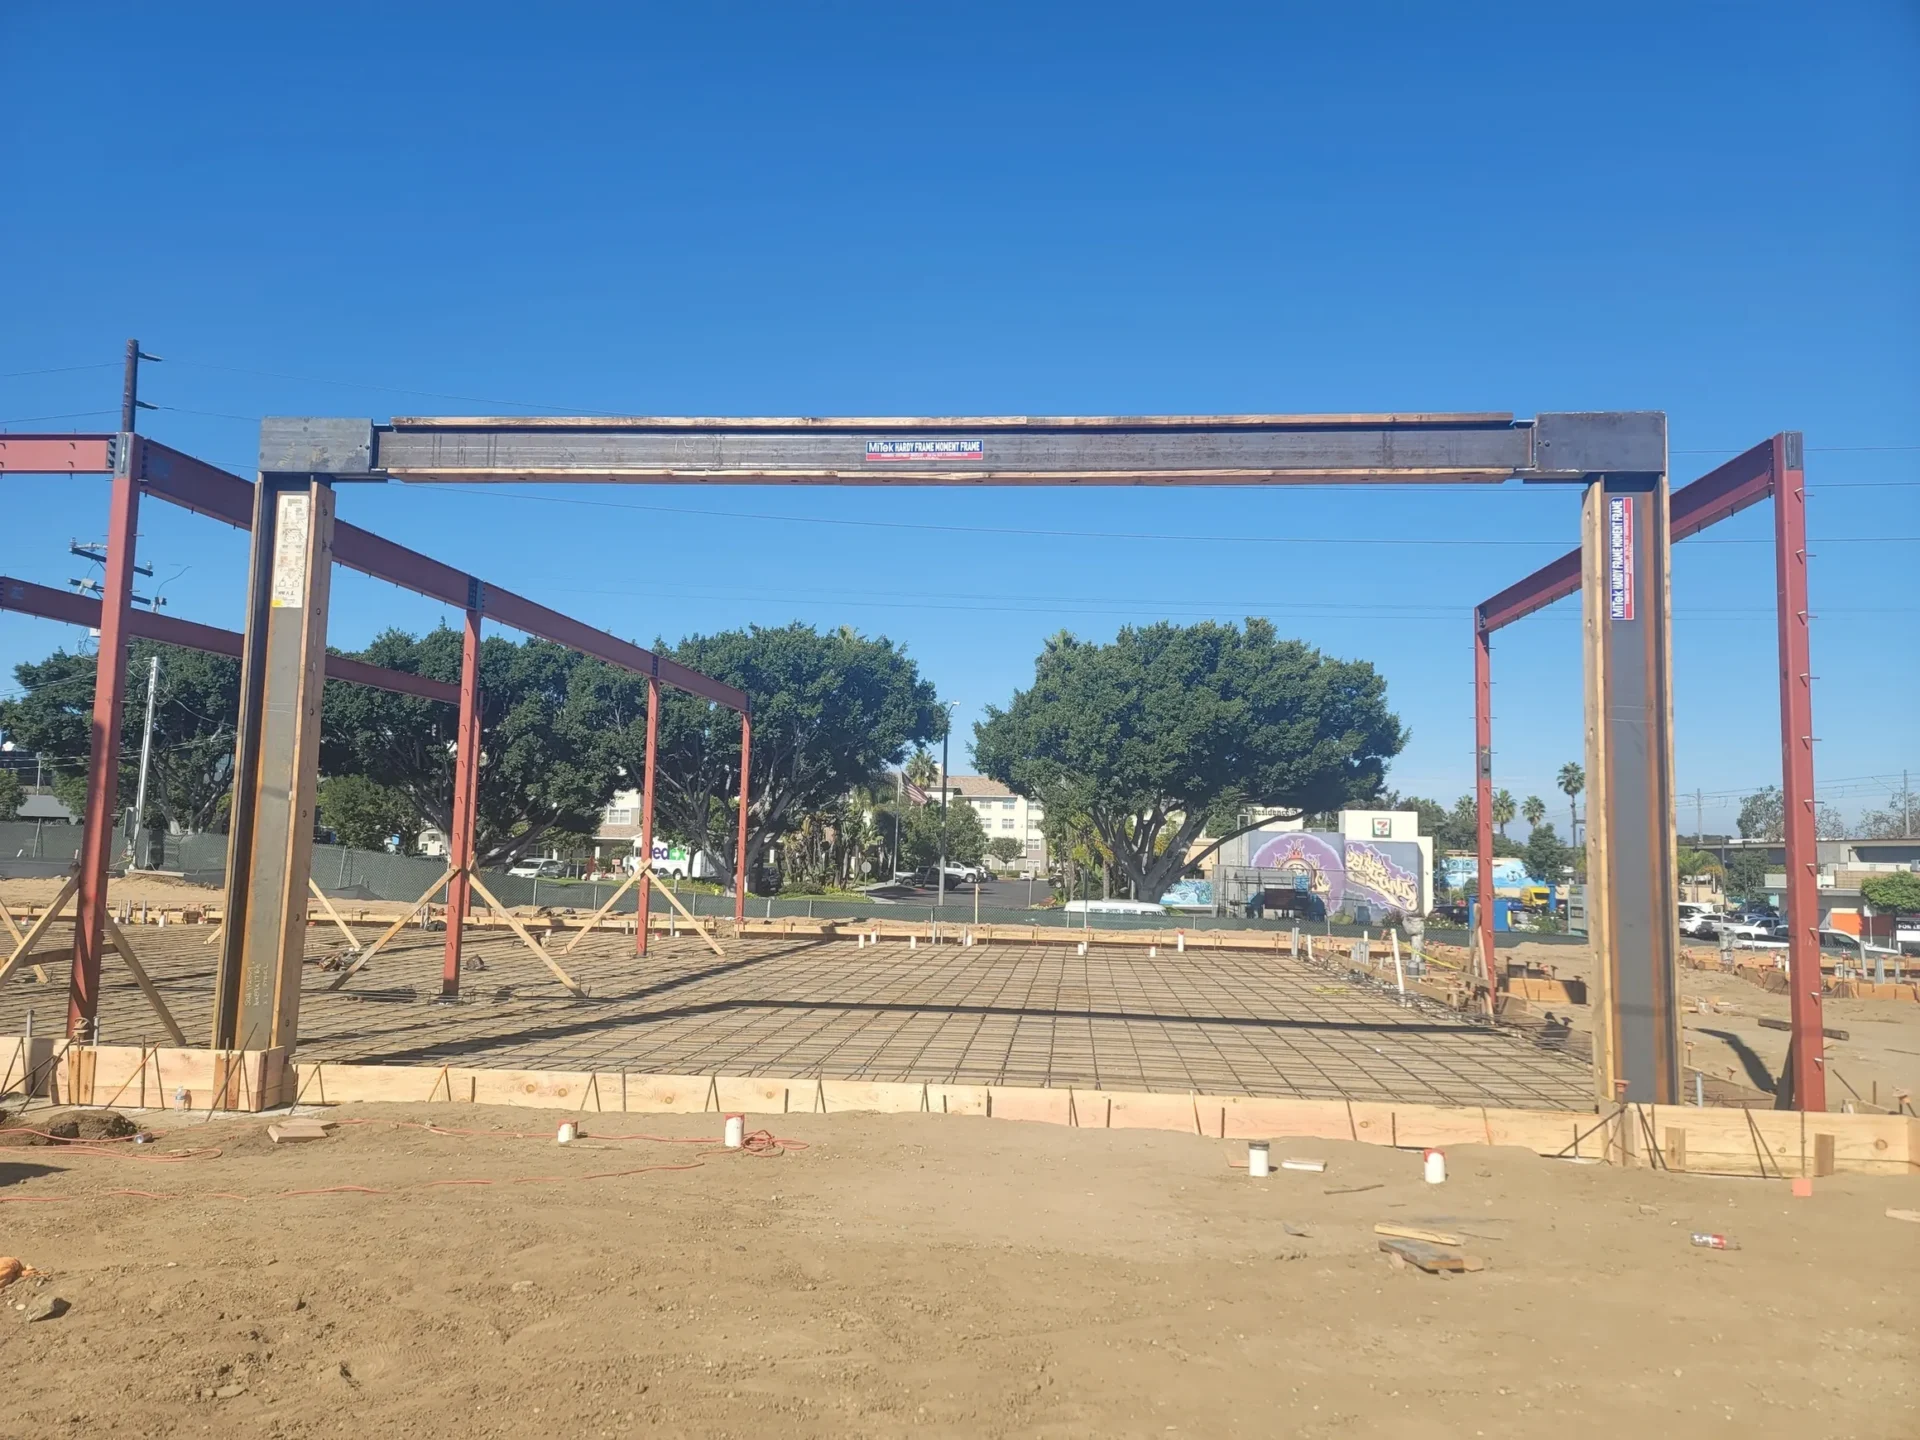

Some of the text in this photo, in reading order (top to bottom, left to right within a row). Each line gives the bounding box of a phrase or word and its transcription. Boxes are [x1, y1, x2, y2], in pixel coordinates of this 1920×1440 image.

[868, 442, 980, 452] MiTek HARDY FRAME MOMENT FRAME
[1611, 500, 1624, 617] MiTek HARDY FRAME MOMENT FRAME
[651, 847, 686, 861] edEx
